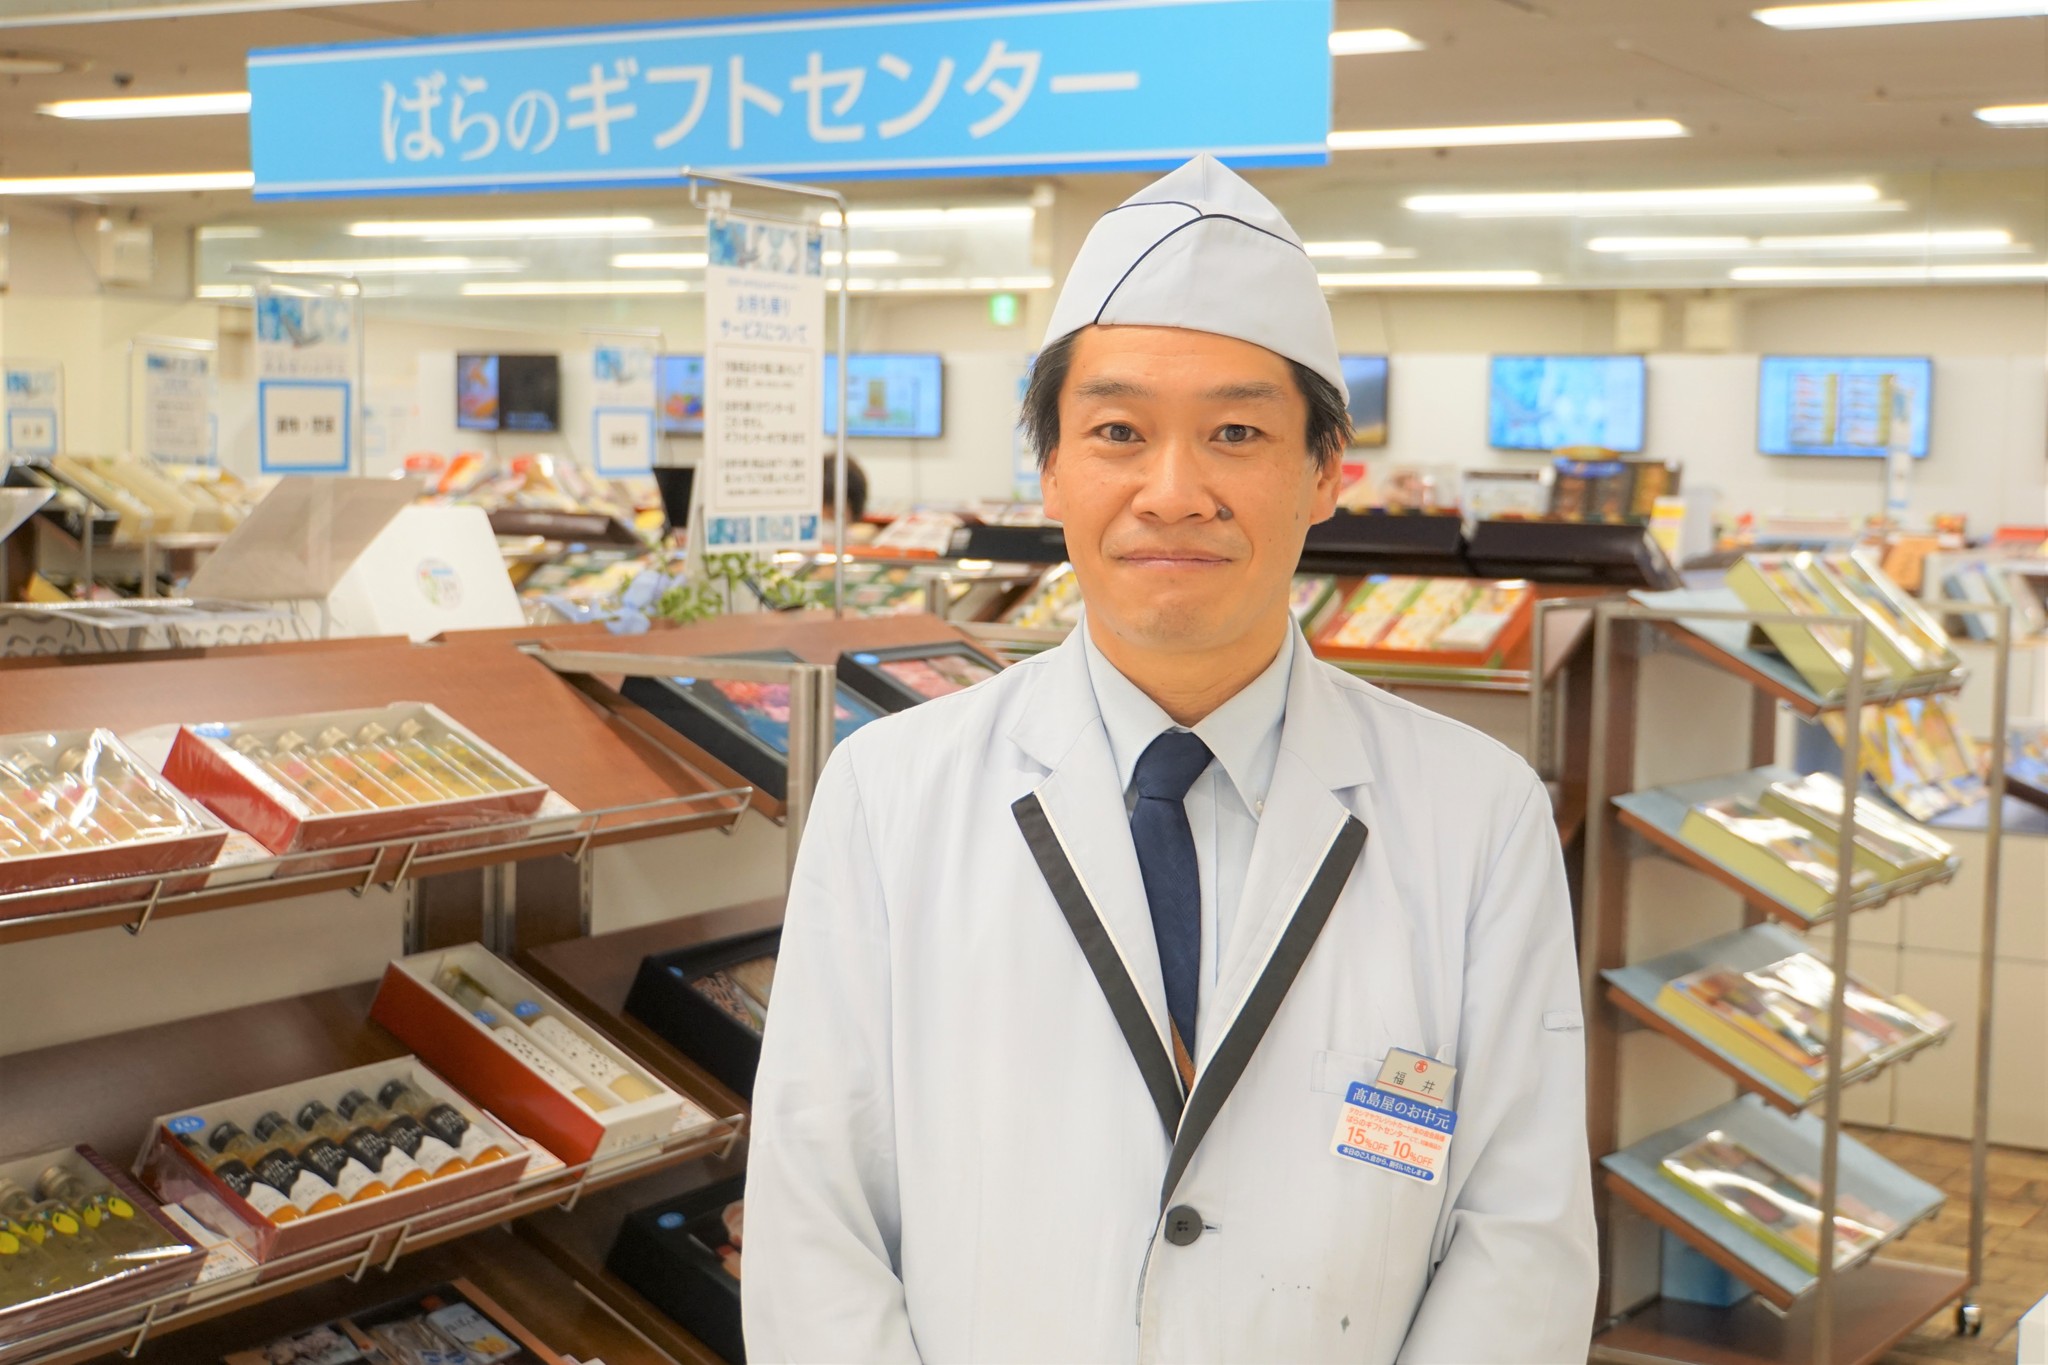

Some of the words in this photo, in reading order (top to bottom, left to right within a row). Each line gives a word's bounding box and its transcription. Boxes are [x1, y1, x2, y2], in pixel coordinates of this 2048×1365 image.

[380, 39, 1140, 164] ばらのギフトセンター
[1347, 1126, 1389, 1152] 15%OFF
[1393, 1140, 1434, 1166] 10%OFF
